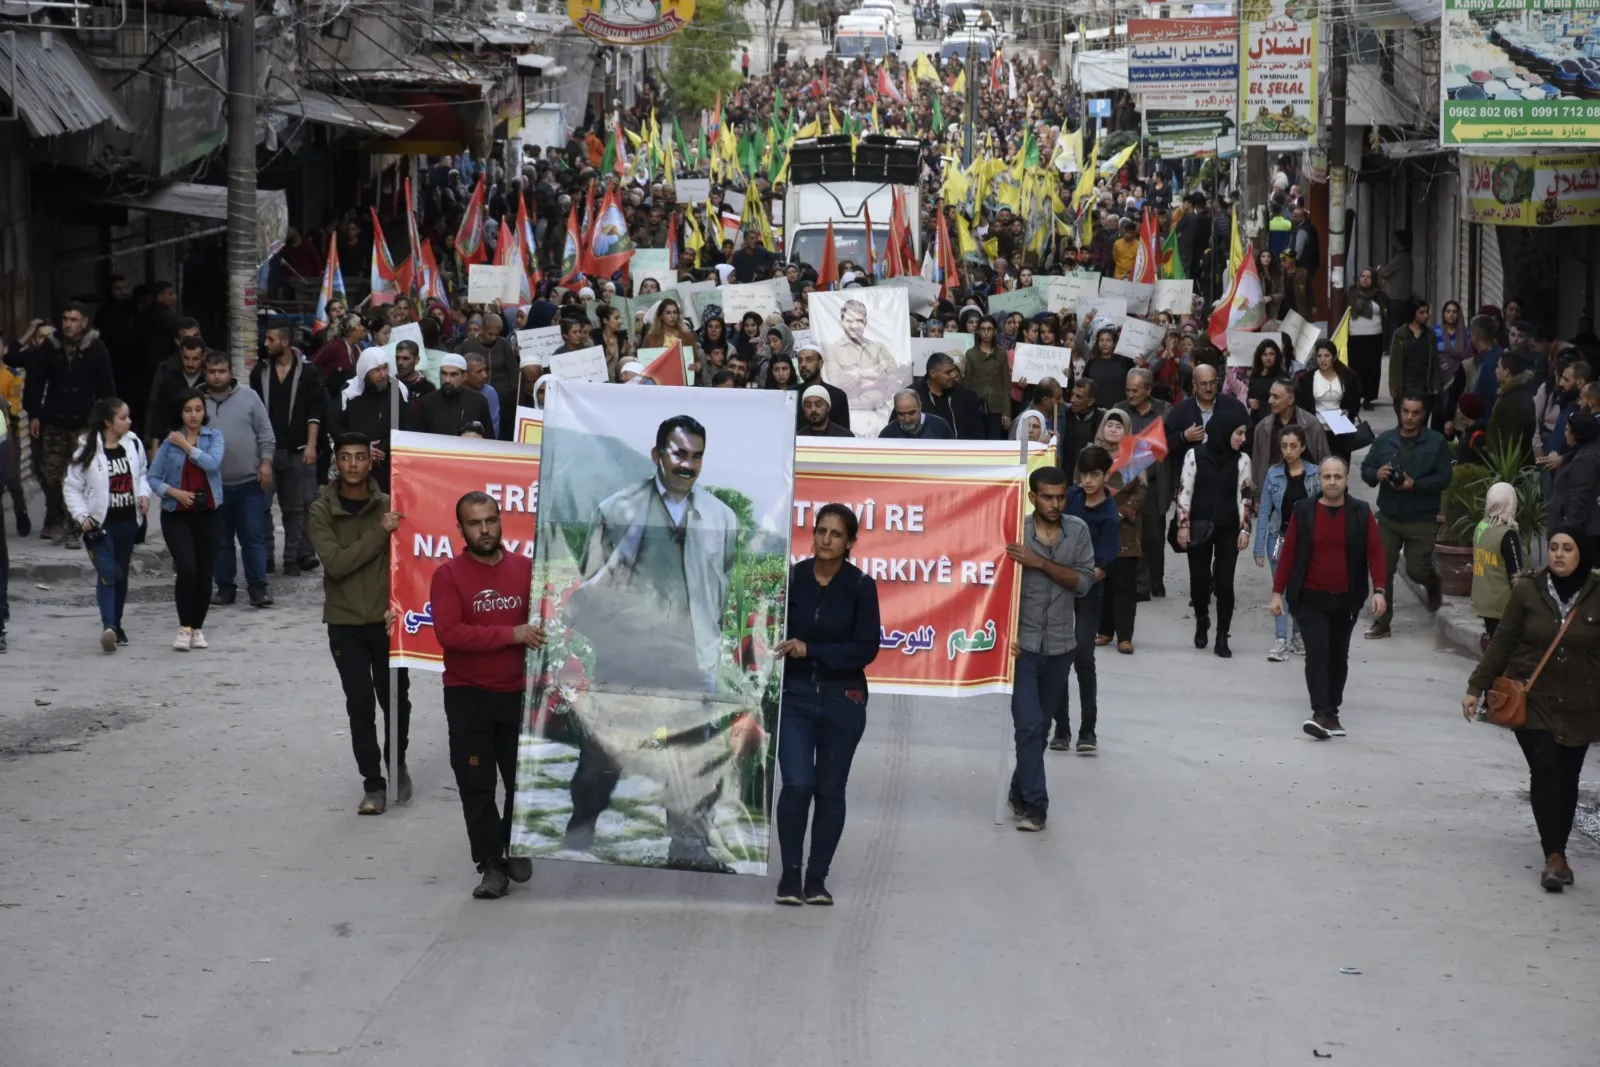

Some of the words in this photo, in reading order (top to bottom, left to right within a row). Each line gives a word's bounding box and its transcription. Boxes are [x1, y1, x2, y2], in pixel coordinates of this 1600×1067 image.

[1130, 45, 1177, 63] الطبية
[1180, 43, 1234, 62] للتحاليل
[1248, 36, 1311, 59] الشلال
[1249, 82, 1264, 94] EL
[1267, 82, 1304, 97] ŞELAL
[1449, 106, 1476, 118] 0962
[1480, 106, 1500, 118] 802
[1504, 106, 1524, 118] 061
[1531, 106, 1558, 118] 0991
[1563, 106, 1583, 118] 712
[1506, 126, 1528, 138] كمال
[1530, 127, 1553, 137] محمد
[884, 503, 925, 532] RE
[413, 533, 454, 559] NA
[960, 561, 995, 585] RE
[947, 619, 997, 660] نعم
